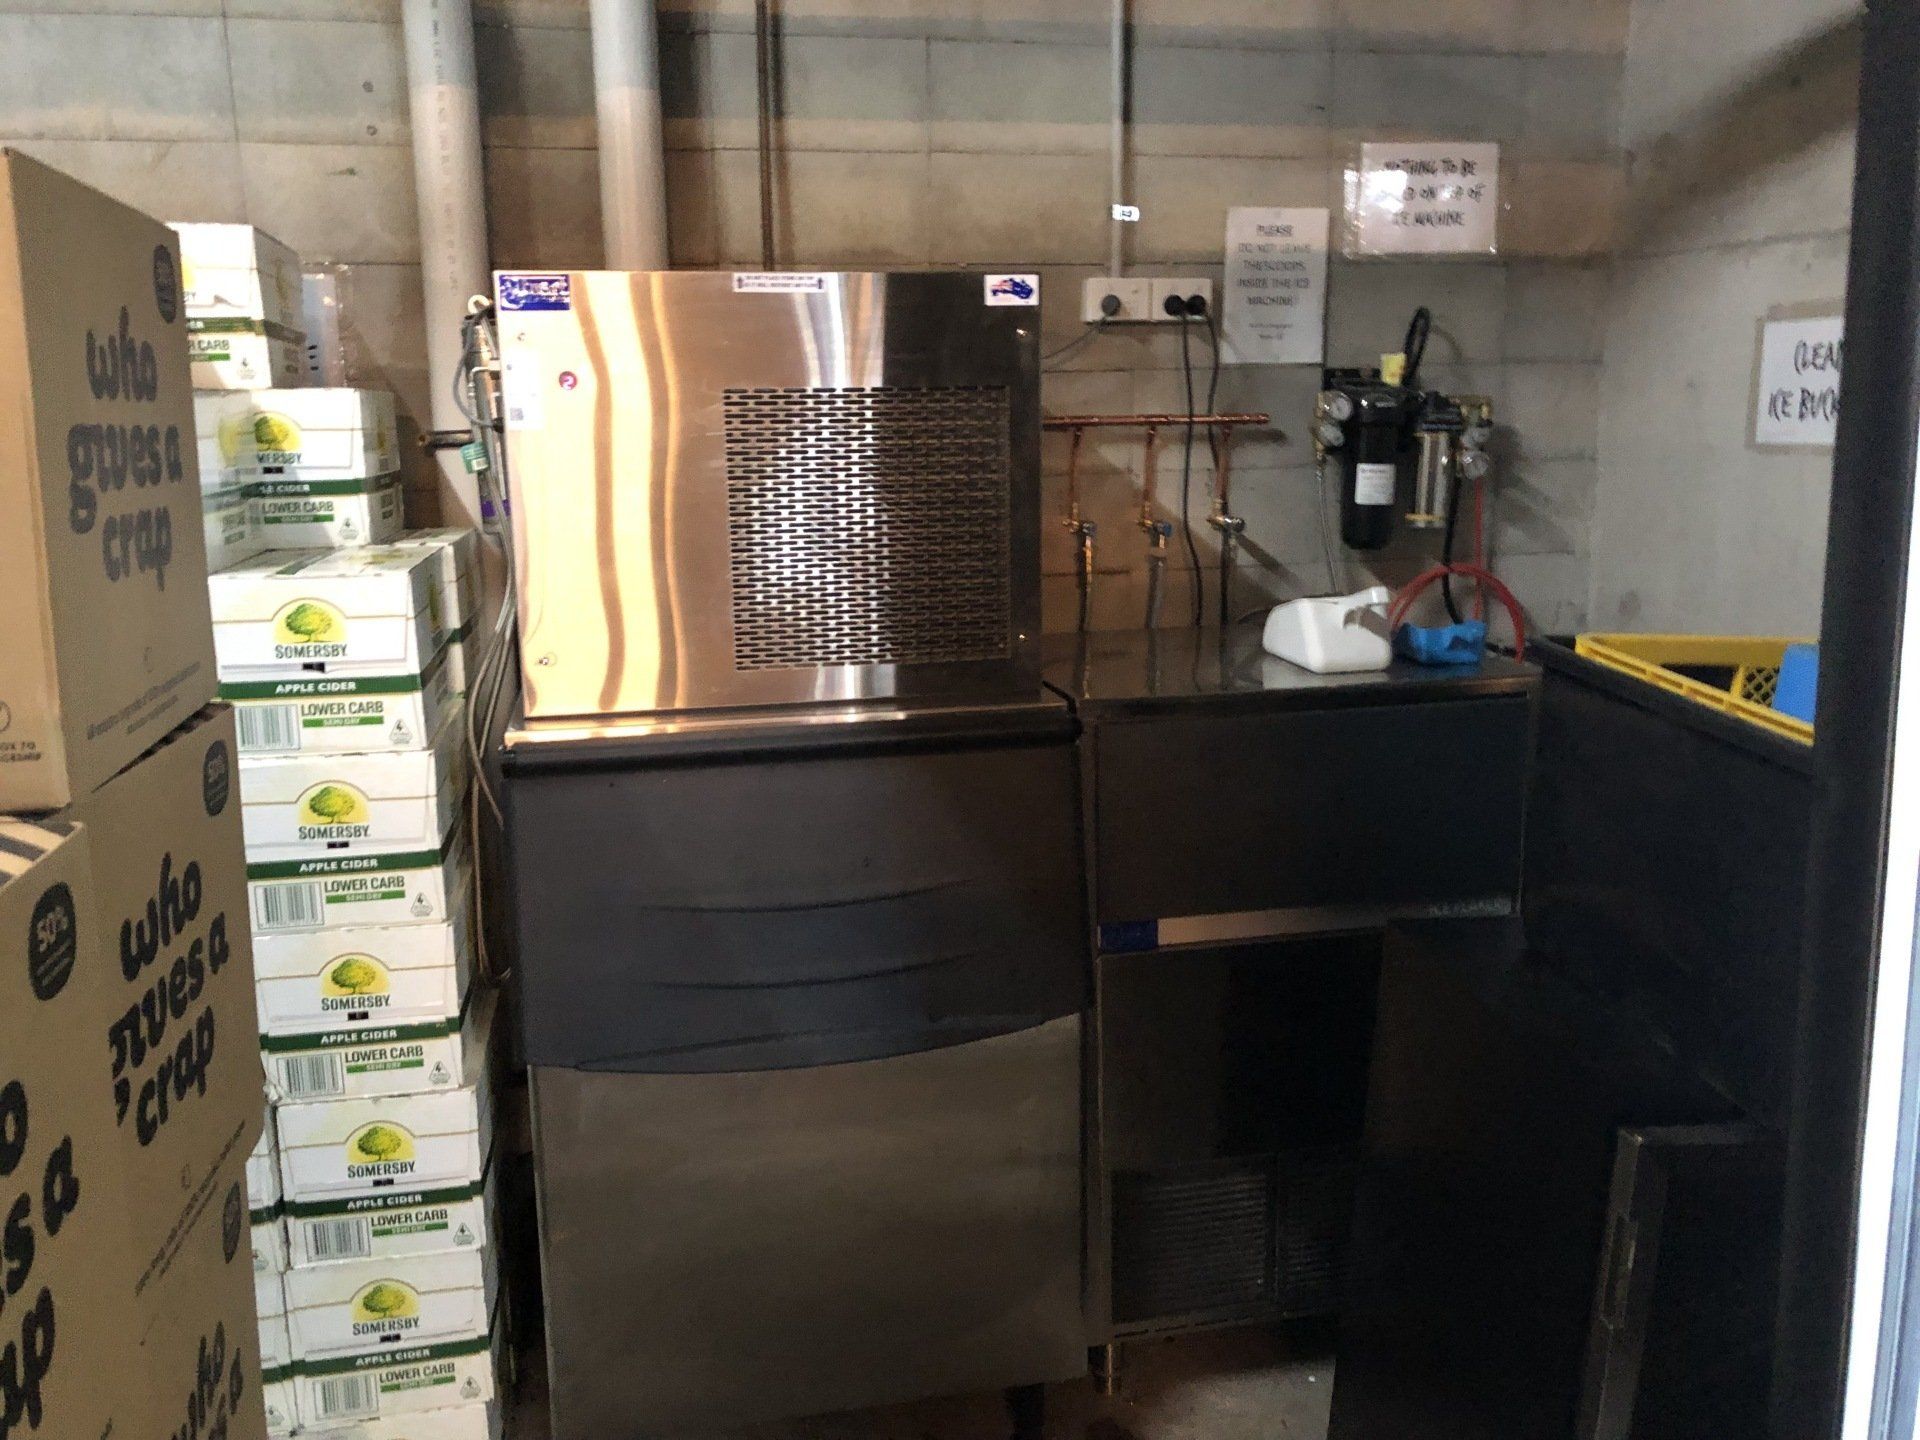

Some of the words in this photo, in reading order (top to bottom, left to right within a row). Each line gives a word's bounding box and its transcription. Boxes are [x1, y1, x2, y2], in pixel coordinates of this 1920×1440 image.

[86, 305, 157, 401] who
[1768, 388, 1793, 421] ICE
[164, 424, 183, 482] a
[262, 502, 300, 514] LOWER
[303, 500, 333, 513] CARB
[102, 505, 174, 592] crap
[275, 643, 347, 659] SOMERSBY
[275, 682, 315, 694] APPLE
[317, 681, 356, 692] CIDER
[301, 703, 346, 716] LOWER
[349, 701, 383, 713] CARB
[298, 825, 370, 839] SOMERSBY
[299, 861, 337, 873] APPLE
[340, 858, 378, 869] CIDER
[324, 879, 368, 892] LOWER
[370, 876, 405, 889] CARB
[120, 852, 202, 982] who
[321, 995, 390, 1011] SOMERSBY
[320, 1033, 358, 1045] APPLE
[361, 1029, 397, 1041] CIDER
[345, 1049, 389, 1063] LOWER
[390, 1045, 423, 1059] CARB
[136, 1005, 215, 1147] crap
[347, 1161, 415, 1179] SOMERSBY
[347, 1198, 384, 1210] APPLE
[386, 1194, 422, 1206] CIDER
[370, 1213, 413, 1227] LOWER
[415, 1209, 448, 1222] CARB
[353, 1316, 419, 1335] SOMERSBY
[355, 1354, 392, 1367] APPLE
[395, 1349, 430, 1361] CIDER
[379, 1368, 420, 1384] LOWER
[423, 1362, 455, 1377] CARB
